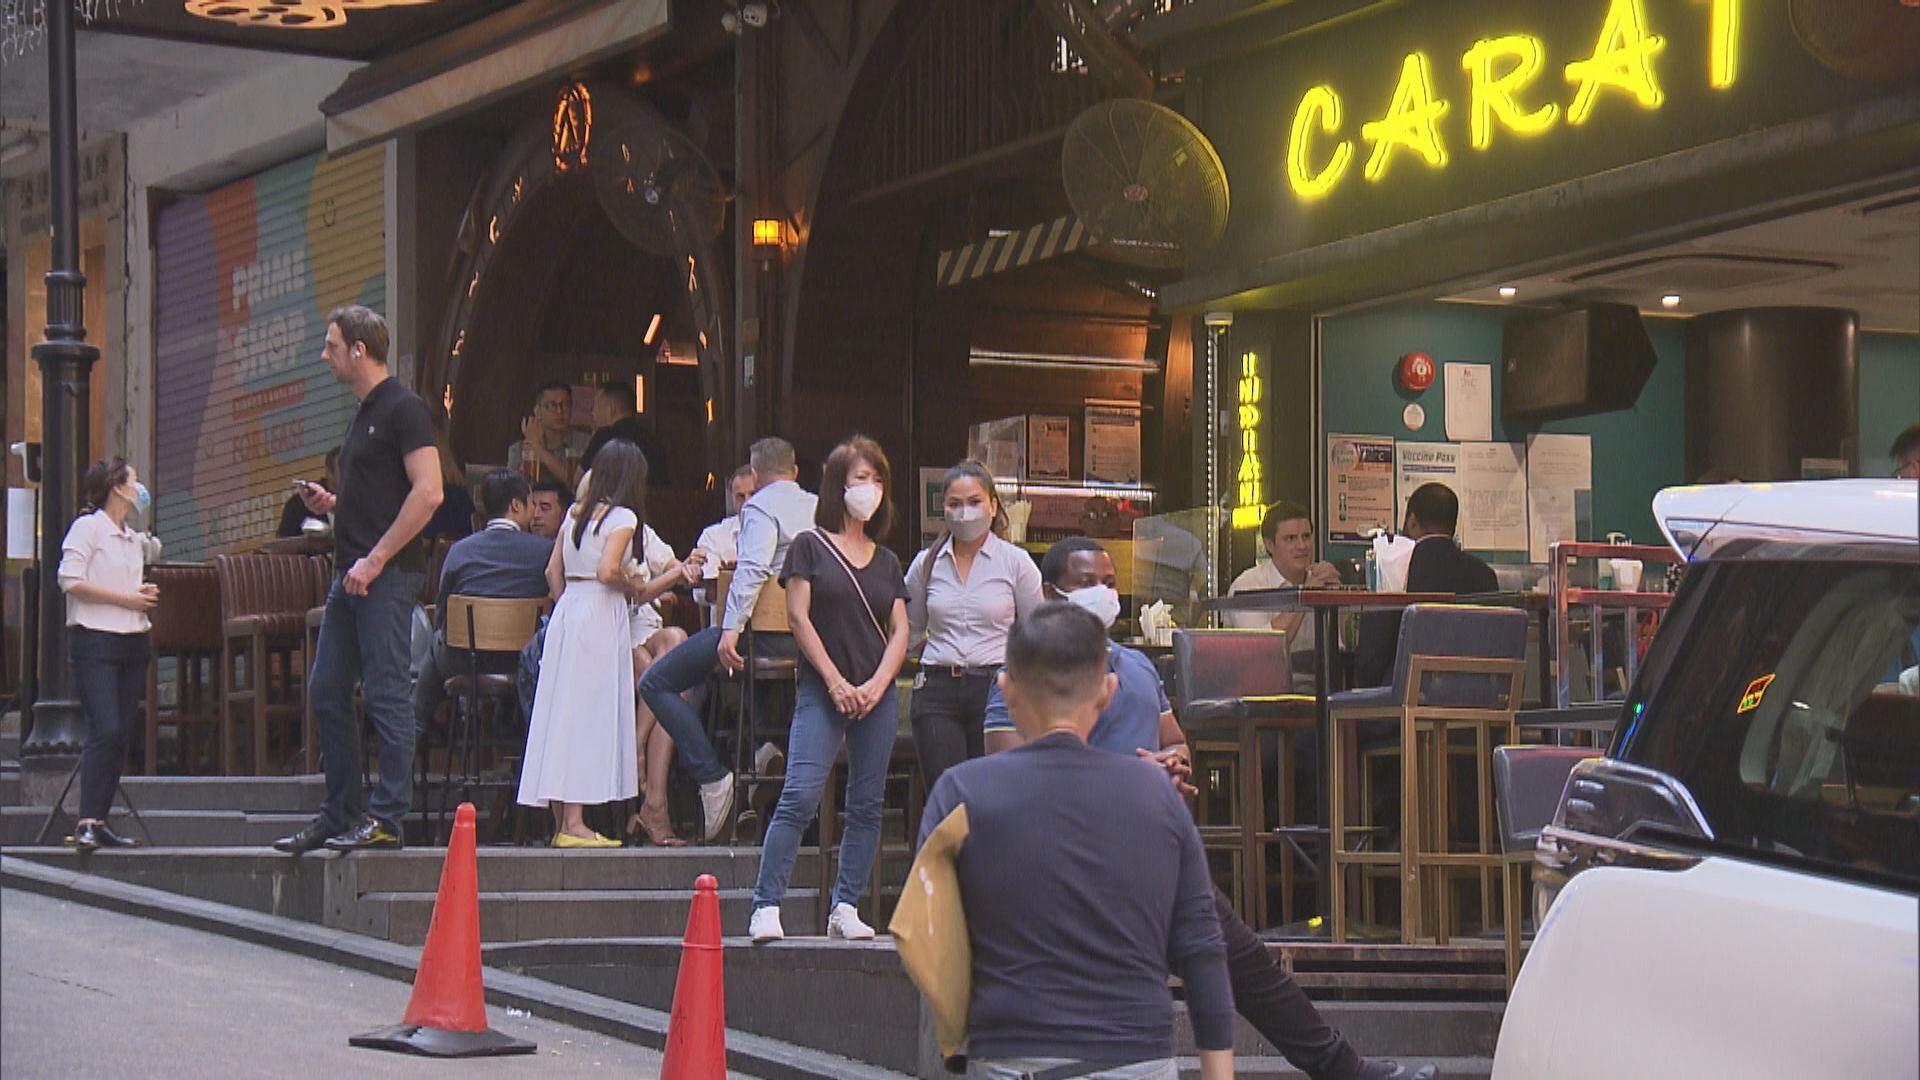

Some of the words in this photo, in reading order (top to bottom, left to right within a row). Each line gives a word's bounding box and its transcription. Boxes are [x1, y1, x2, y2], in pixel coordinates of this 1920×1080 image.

[232, 249, 304, 312] PRIME
[233, 308, 304, 382] SHOP
[232, 431, 260, 463] FOR
[264, 418, 304, 456] LEASE
[1238, 352, 1262, 506] INDIAN
